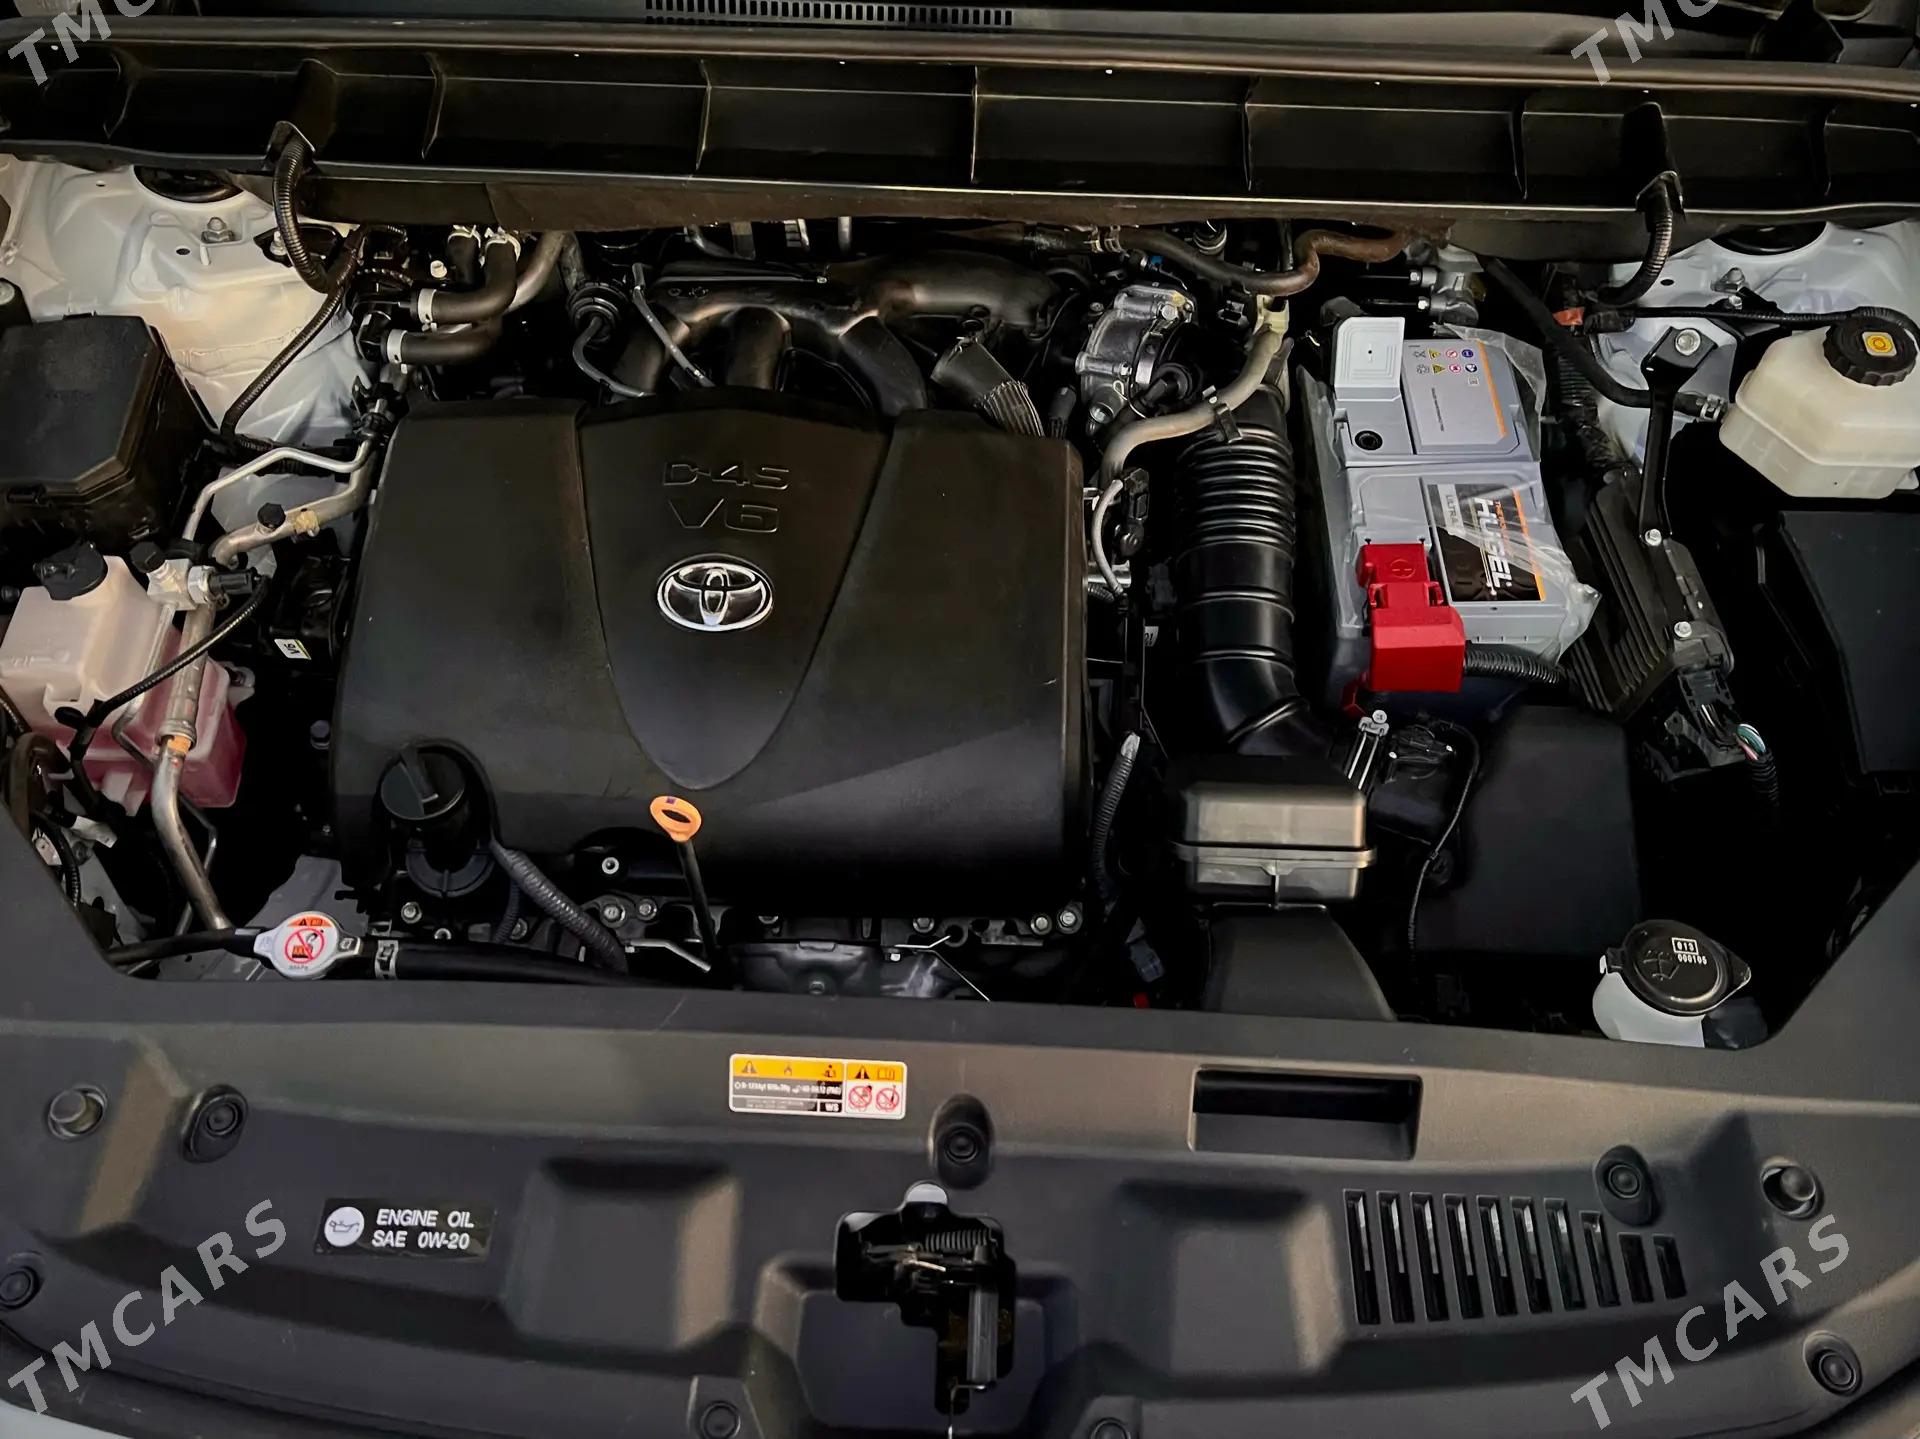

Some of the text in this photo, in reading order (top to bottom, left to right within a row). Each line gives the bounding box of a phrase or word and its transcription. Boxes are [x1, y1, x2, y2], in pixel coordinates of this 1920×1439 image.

[663, 461, 789, 490] D-4S
[668, 497, 781, 533] V6
[376, 1208, 475, 1229] ENGINE OIL
[371, 1229, 470, 1250] SAE 0W-20
